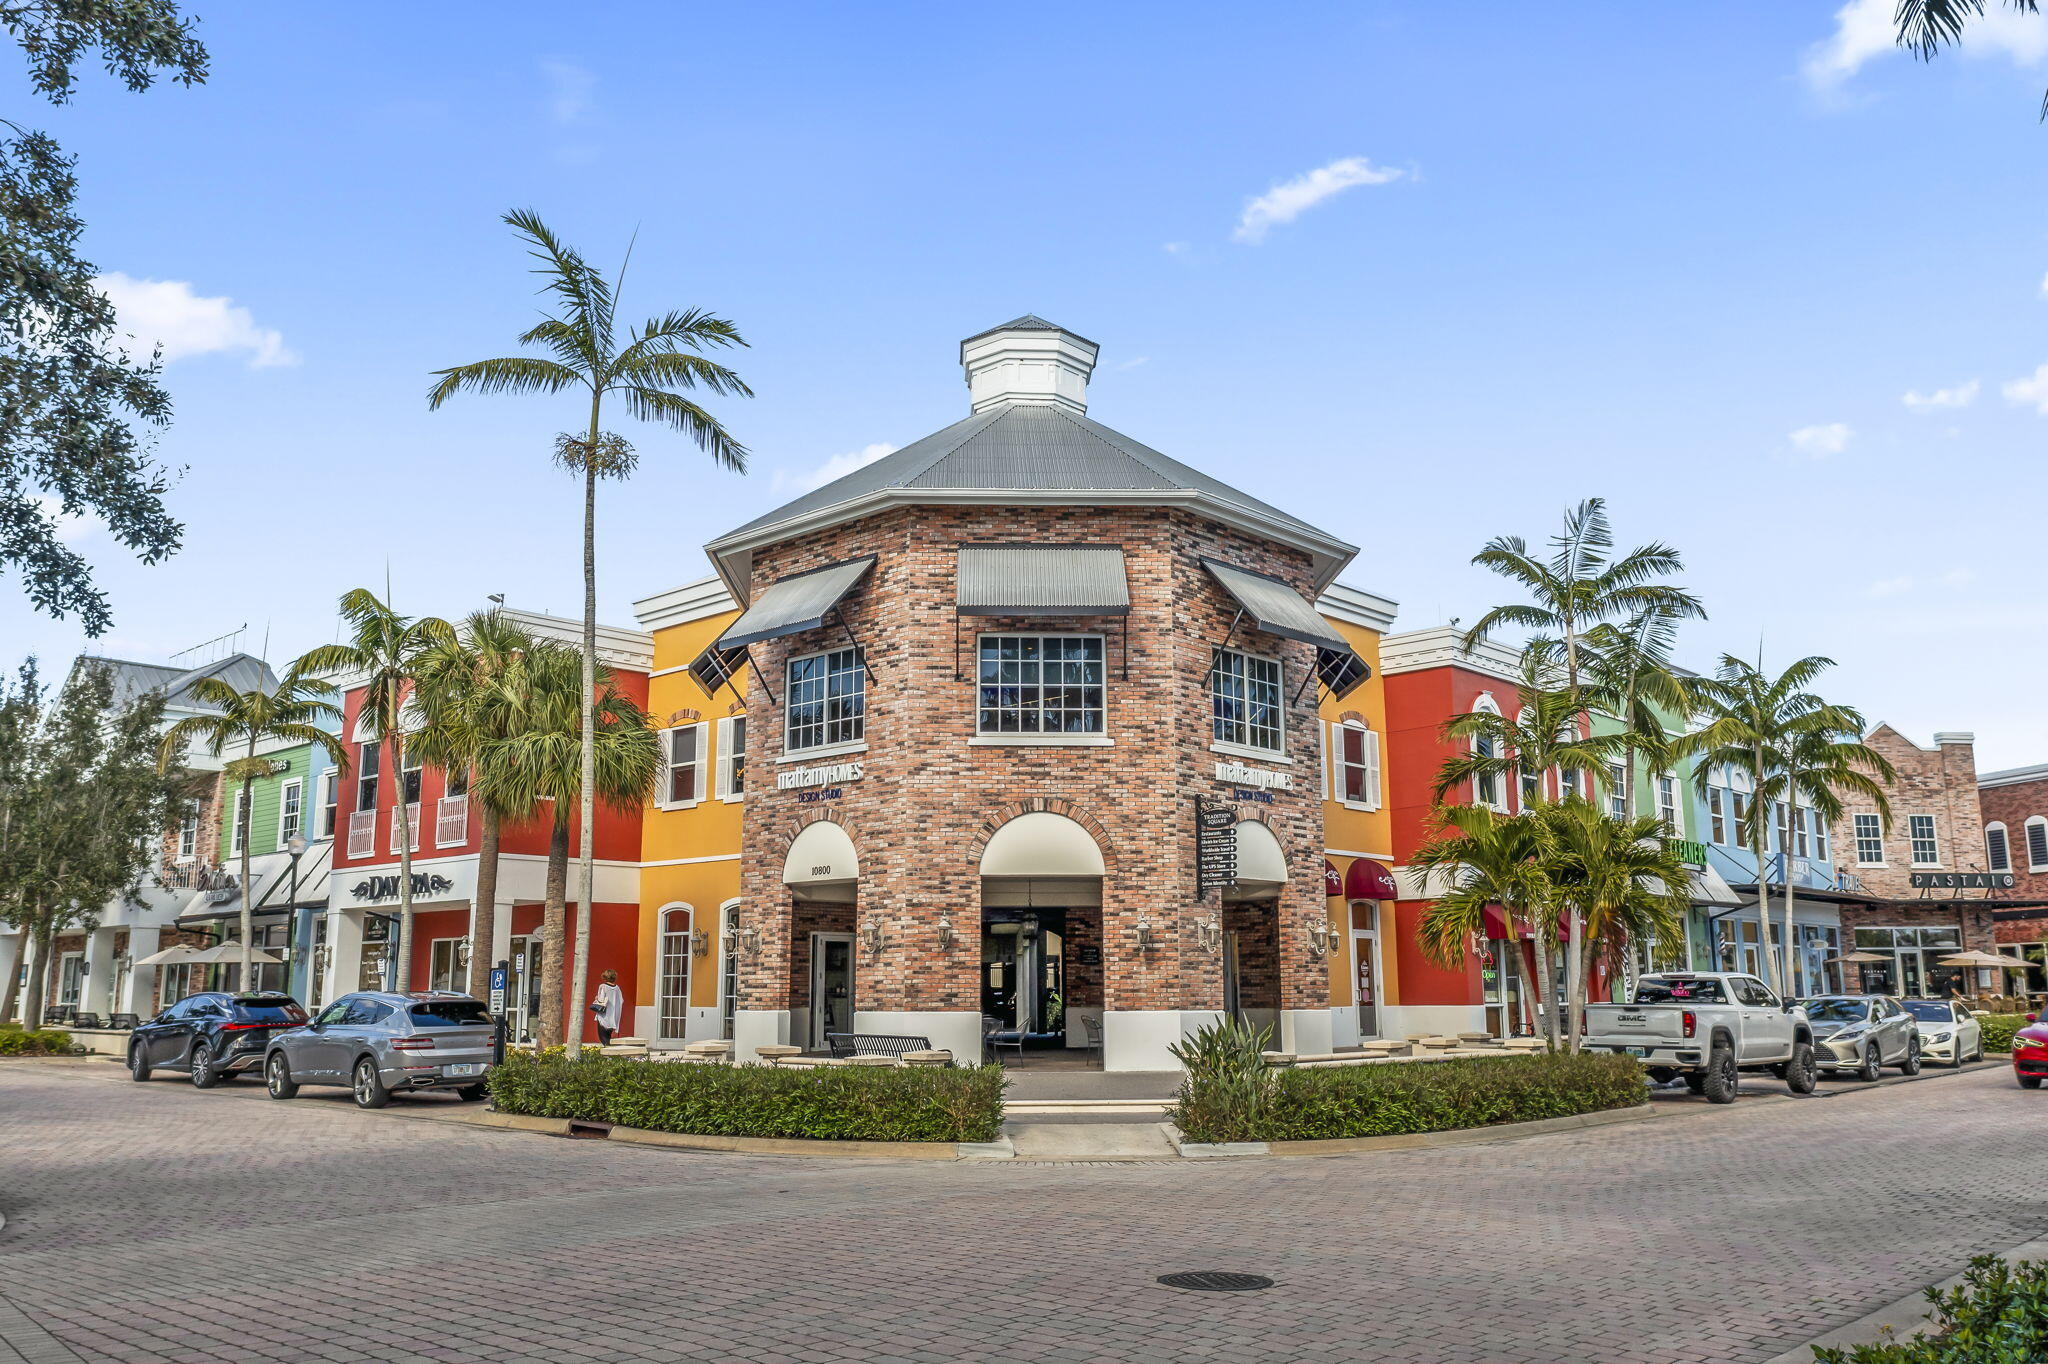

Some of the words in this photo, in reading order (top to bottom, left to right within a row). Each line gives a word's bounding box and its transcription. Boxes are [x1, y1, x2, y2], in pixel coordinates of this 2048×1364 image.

[799, 791, 820, 803] DESIGN
[820, 788, 842, 800] STUDIO
[811, 865, 831, 875] 10800
[1915, 874, 2014, 887] PASTAIO
[368, 875, 402, 899] DAY
[1481, 969, 1496, 979] Open
[1617, 1014, 1647, 1022] GMC
